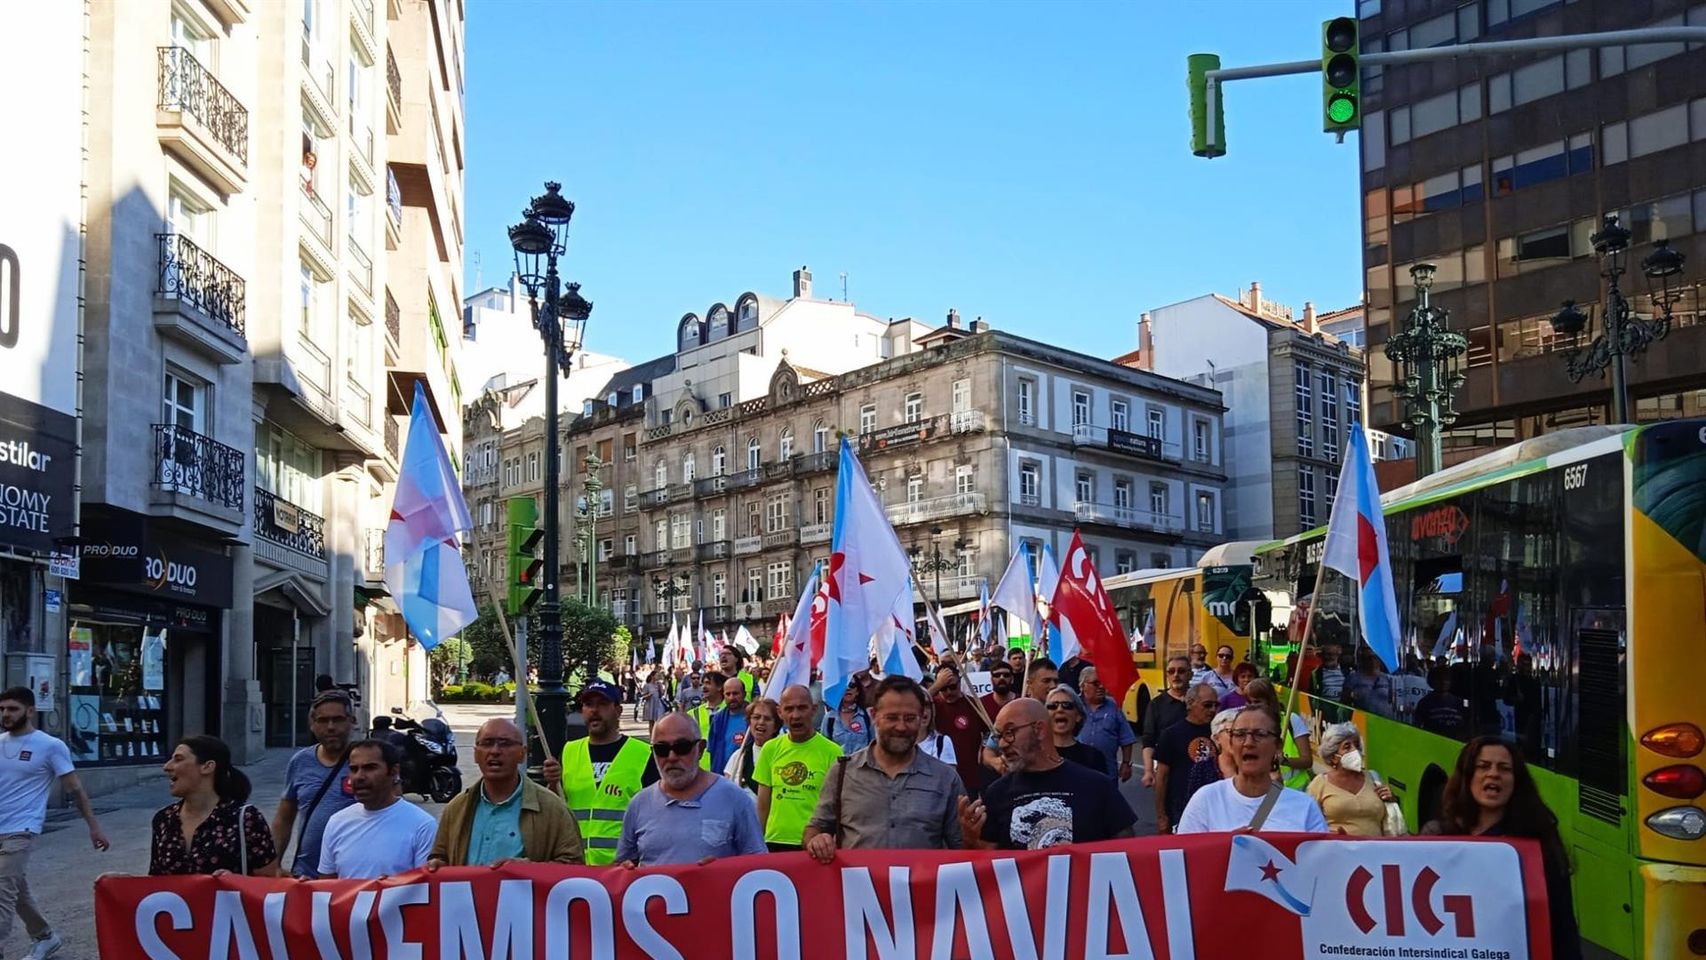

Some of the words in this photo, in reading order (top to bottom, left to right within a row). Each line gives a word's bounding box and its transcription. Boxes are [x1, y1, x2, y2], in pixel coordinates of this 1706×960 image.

[1564, 463, 1588, 490] 6567
[167, 561, 197, 587] DUO
[730, 868, 801, 960] O
[1345, 864, 1476, 938] CIG
[1319, 943, 1396, 958] Confederación
[1398, 947, 1468, 960] Intersindical
[1471, 948, 1510, 960] Galega
